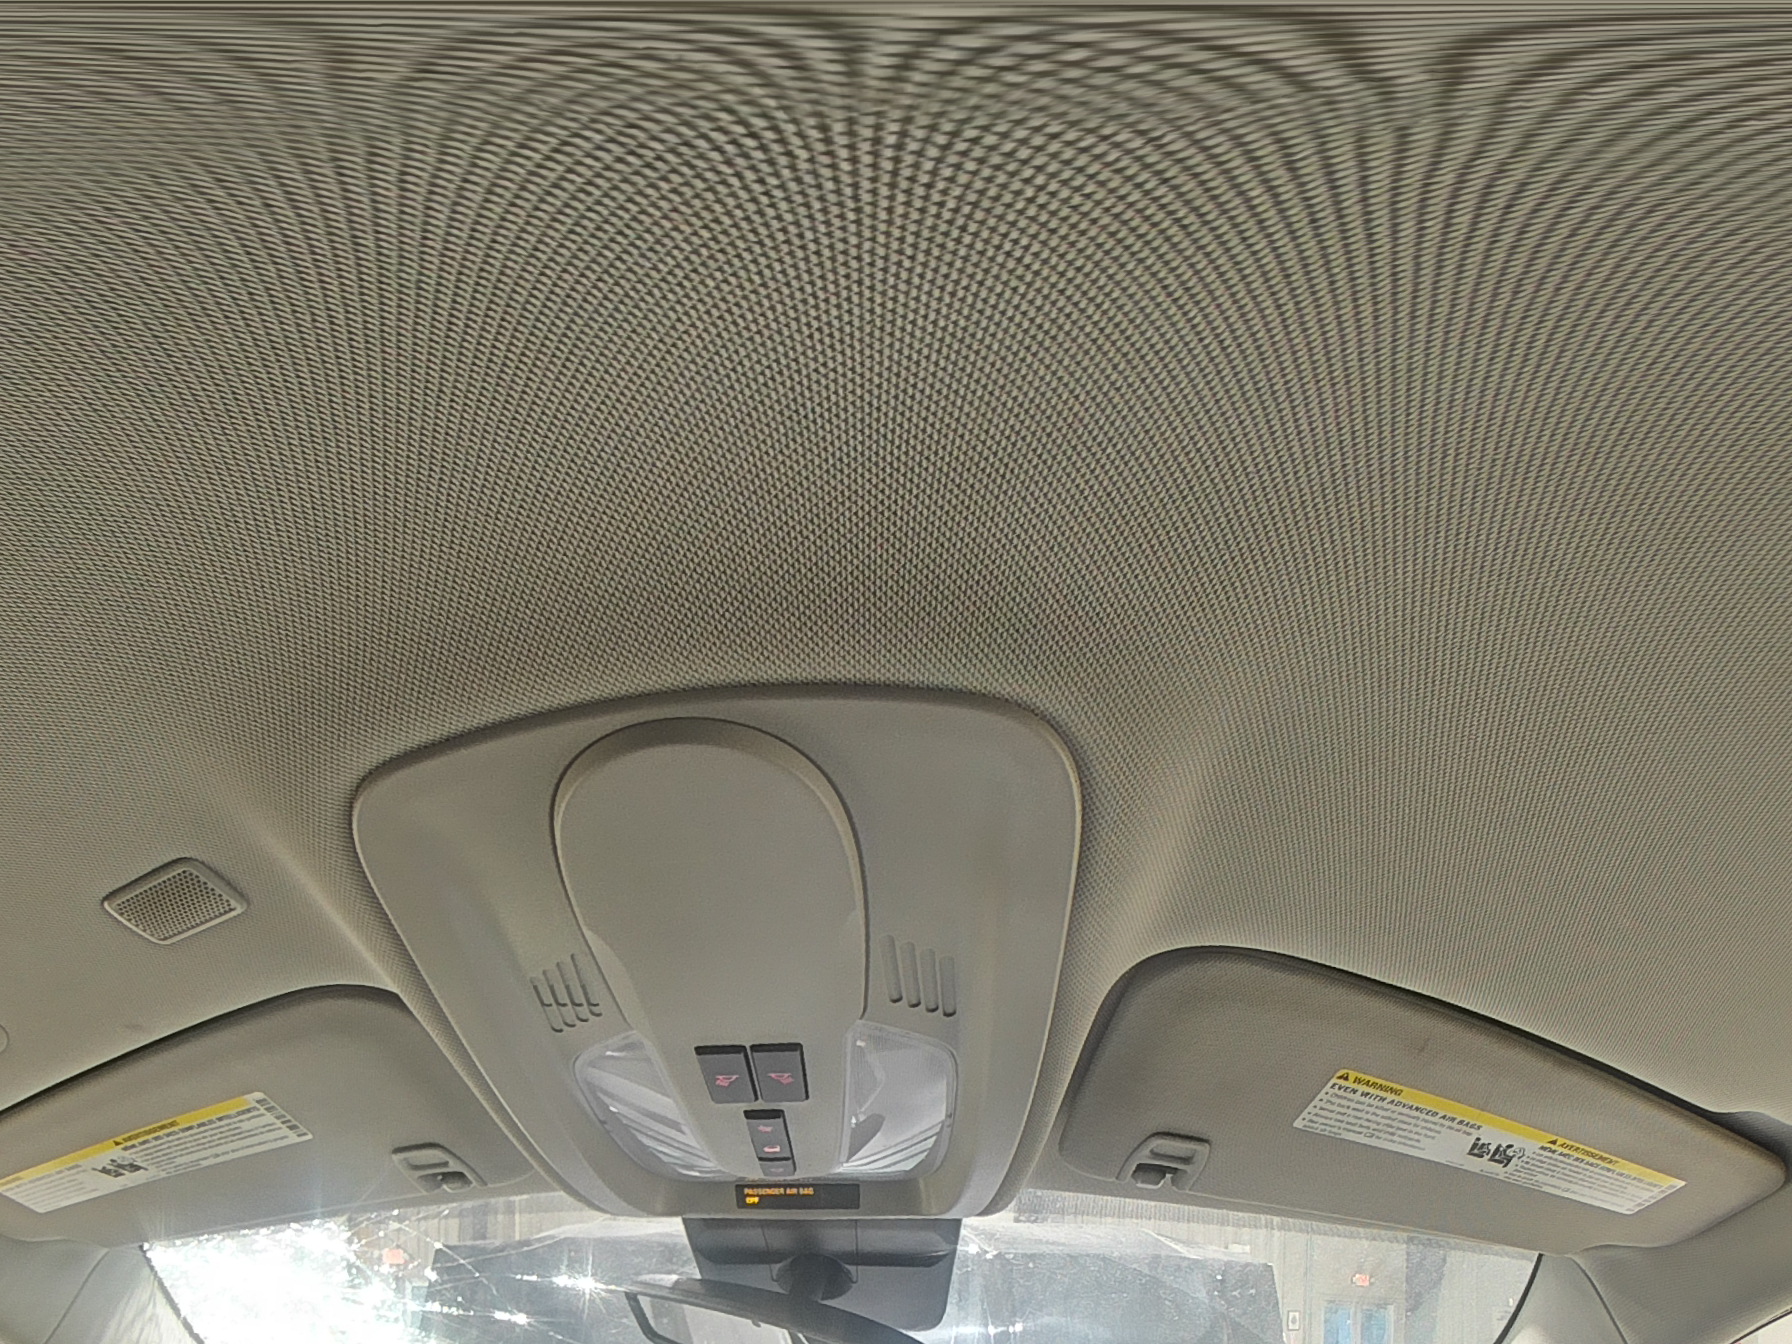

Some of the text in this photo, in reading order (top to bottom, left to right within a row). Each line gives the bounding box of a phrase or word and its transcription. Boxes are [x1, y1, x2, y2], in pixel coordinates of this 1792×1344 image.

[1352, 1075, 1403, 1097] WARNING
[1329, 1082, 1483, 1132] EVEN WITH ADVANCED AIR BAGS
